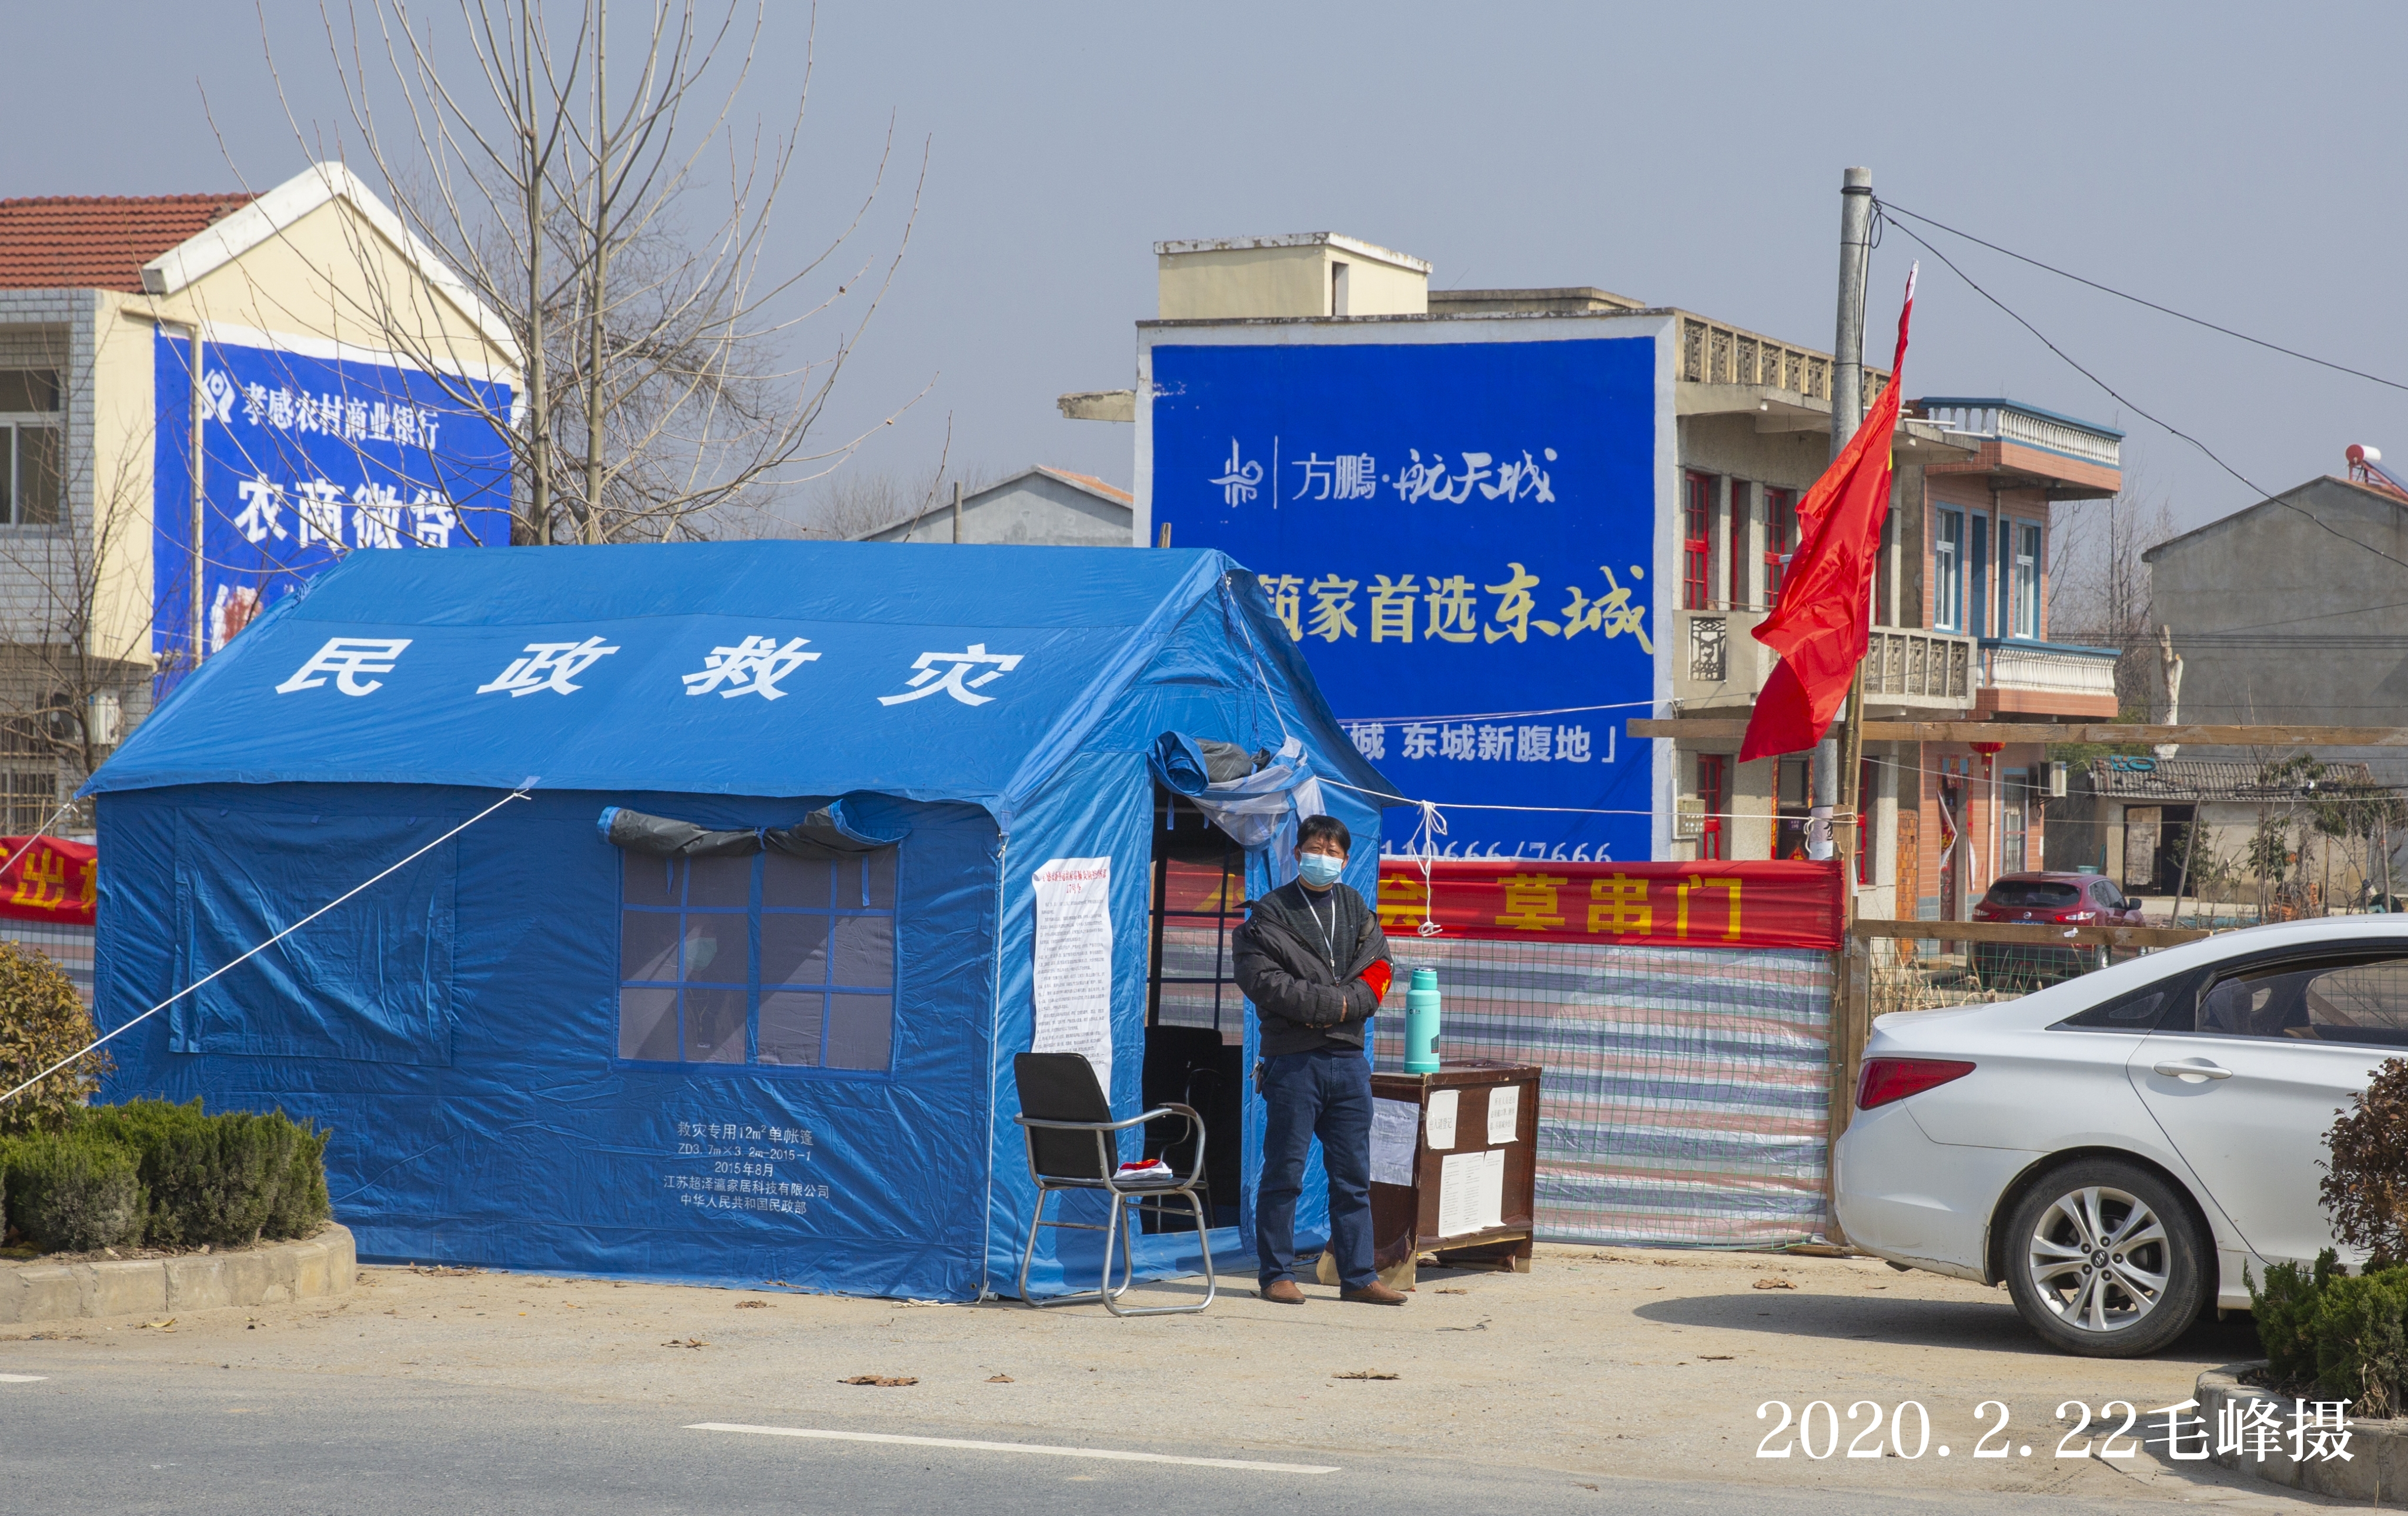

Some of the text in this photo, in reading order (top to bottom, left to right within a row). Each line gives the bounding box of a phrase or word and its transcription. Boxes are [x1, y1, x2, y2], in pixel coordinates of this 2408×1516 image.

[242, 381, 440, 450] 孝感农村商业银行
[234, 473, 456, 551] 农商微贷
[275, 634, 1024, 706] 民政救灾
[681, 1192, 807, 1215] 中华人民共和国民政部
[714, 1161, 774, 1177] 2015年8月
